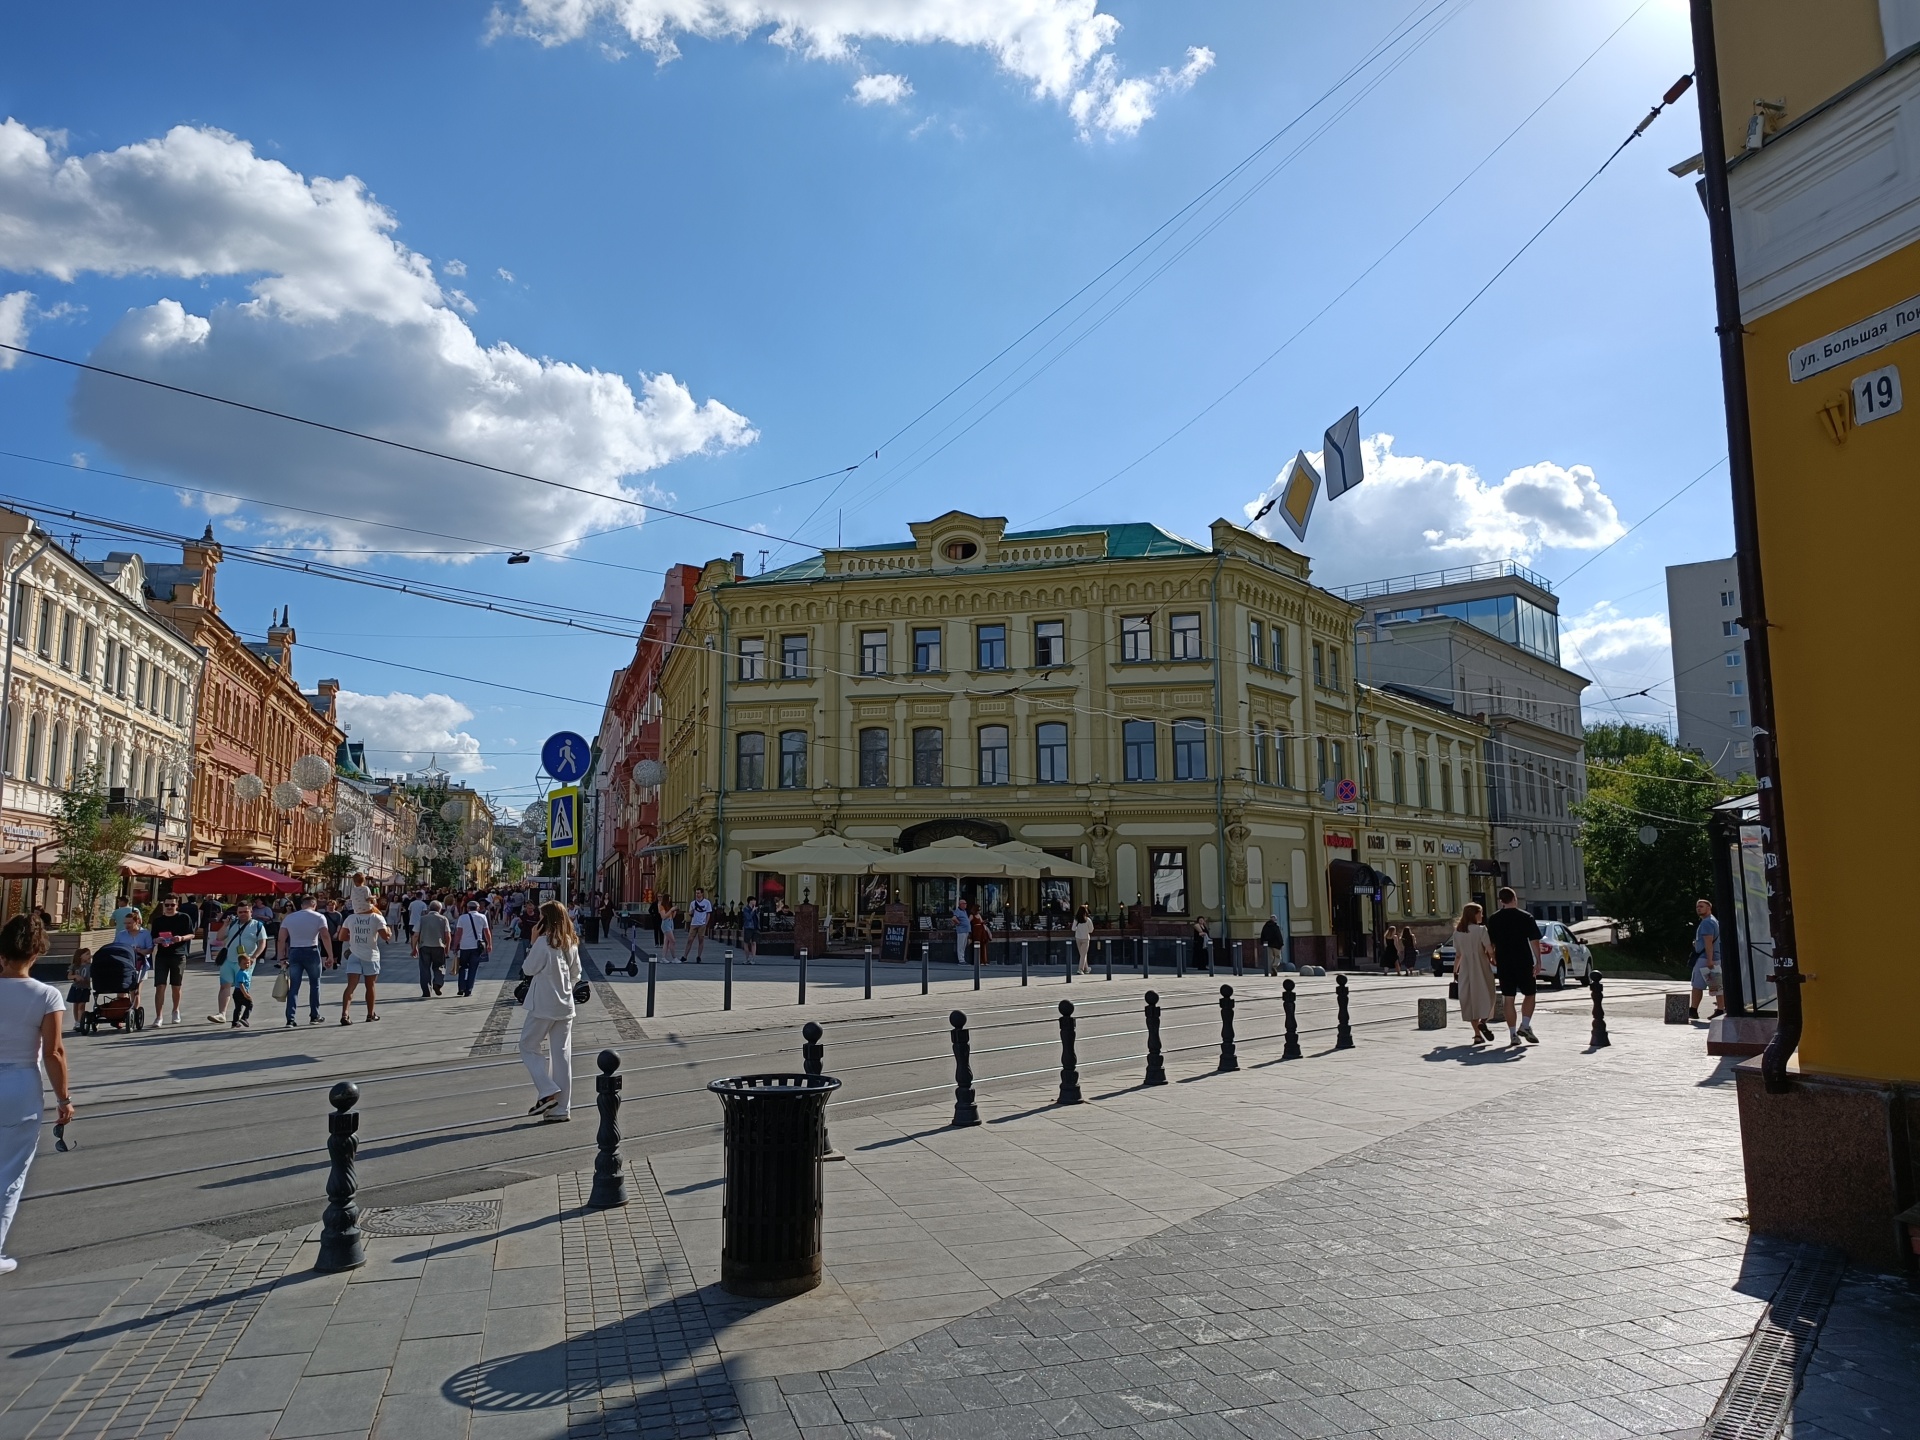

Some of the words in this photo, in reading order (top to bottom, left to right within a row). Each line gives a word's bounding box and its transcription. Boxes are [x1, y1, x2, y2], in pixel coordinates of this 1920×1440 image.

[1800, 353, 1820, 372] ул.
[1823, 322, 1888, 358] Большая
[1861, 375, 1893, 414] 19
[354, 916, 371, 925] Need
[354, 926, 371, 935] More
[354, 935, 368, 944] Rest
